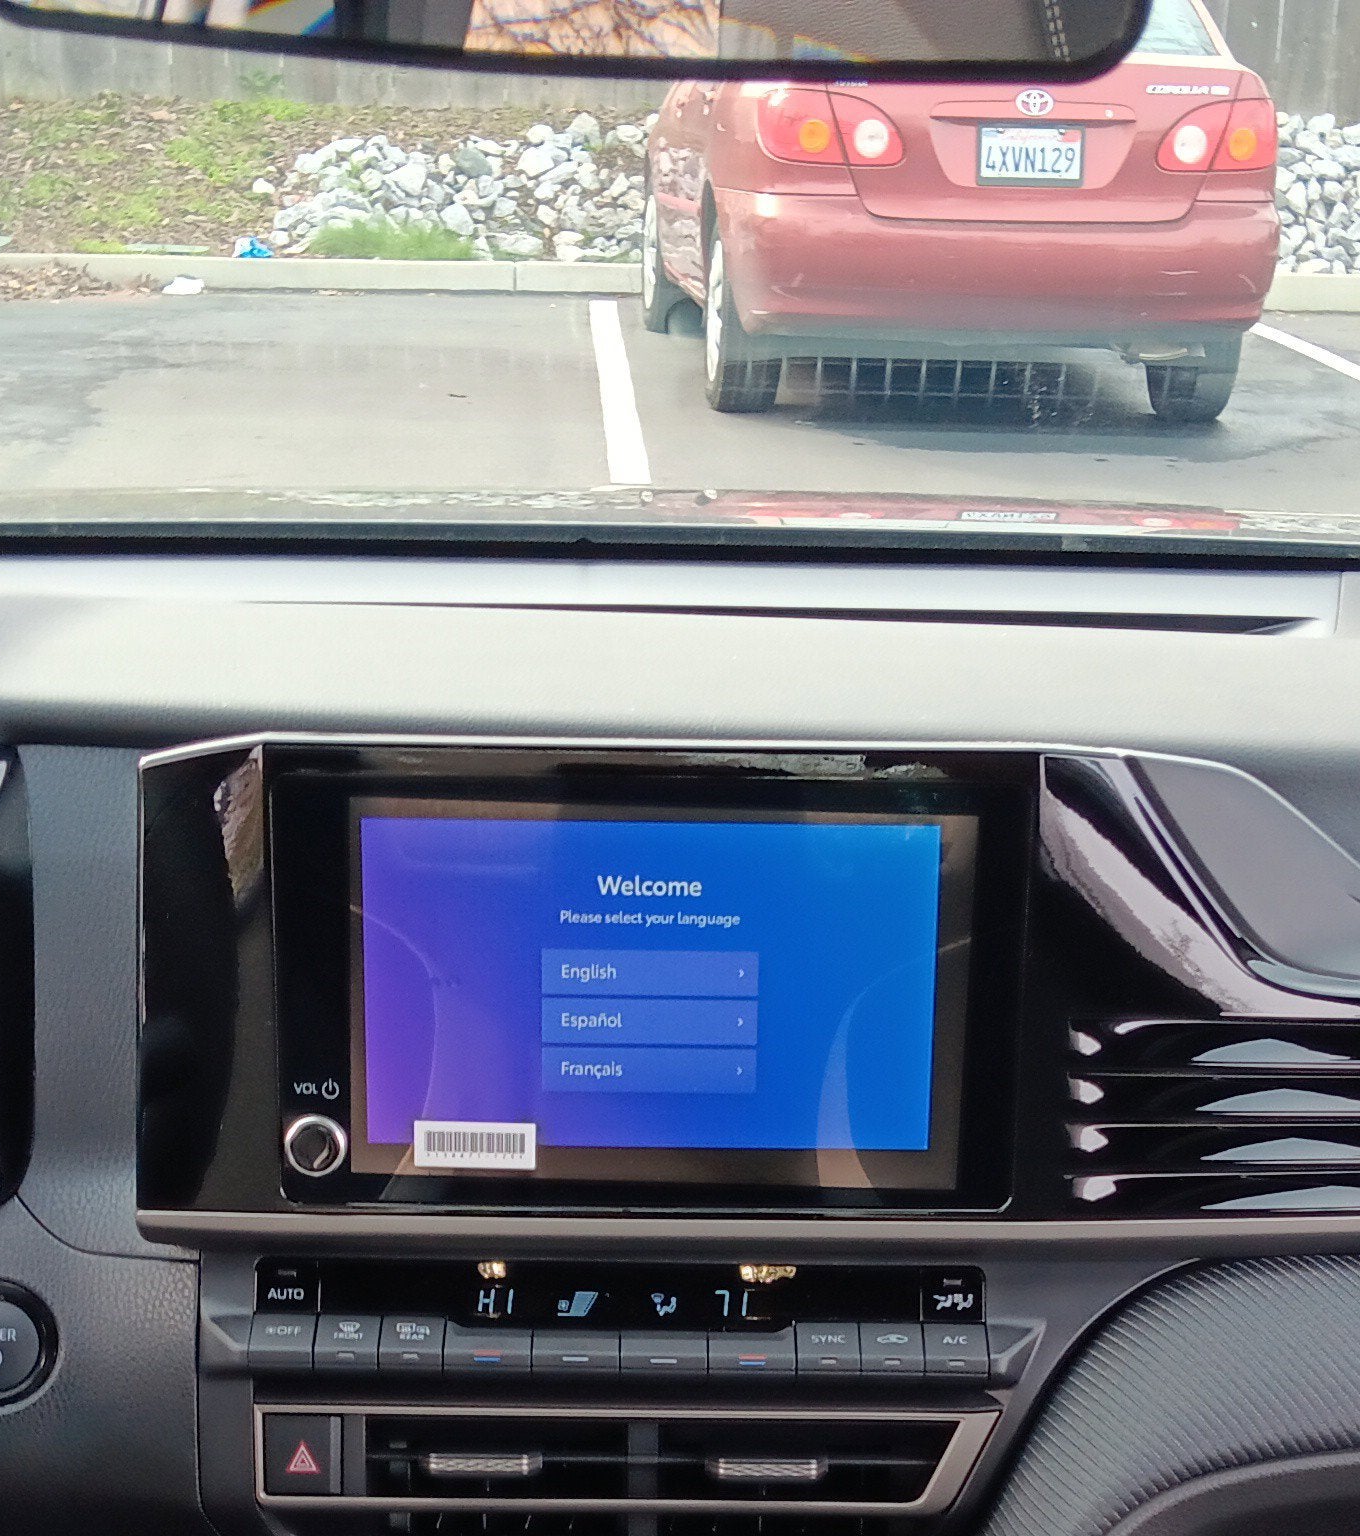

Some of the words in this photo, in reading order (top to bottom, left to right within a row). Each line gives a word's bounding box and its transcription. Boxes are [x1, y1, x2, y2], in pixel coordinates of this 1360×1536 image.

[984, 145, 1076, 174] 4XVN129
[596, 875, 703, 897] Welcome
[559, 909, 602, 925] Please
[604, 910, 642, 925] select
[645, 913, 674, 928] your
[677, 911, 741, 928] language
[561, 963, 617, 983] English
[561, 1011, 623, 1031] Español
[560, 1060, 623, 1080] Français
[293, 1081, 319, 1095] VOL
[267, 1287, 305, 1300] AUTO
[276, 1325, 302, 1337] OFF
[811, 1334, 847, 1345] SYNC
[942, 1335, 969, 1345] A/C
